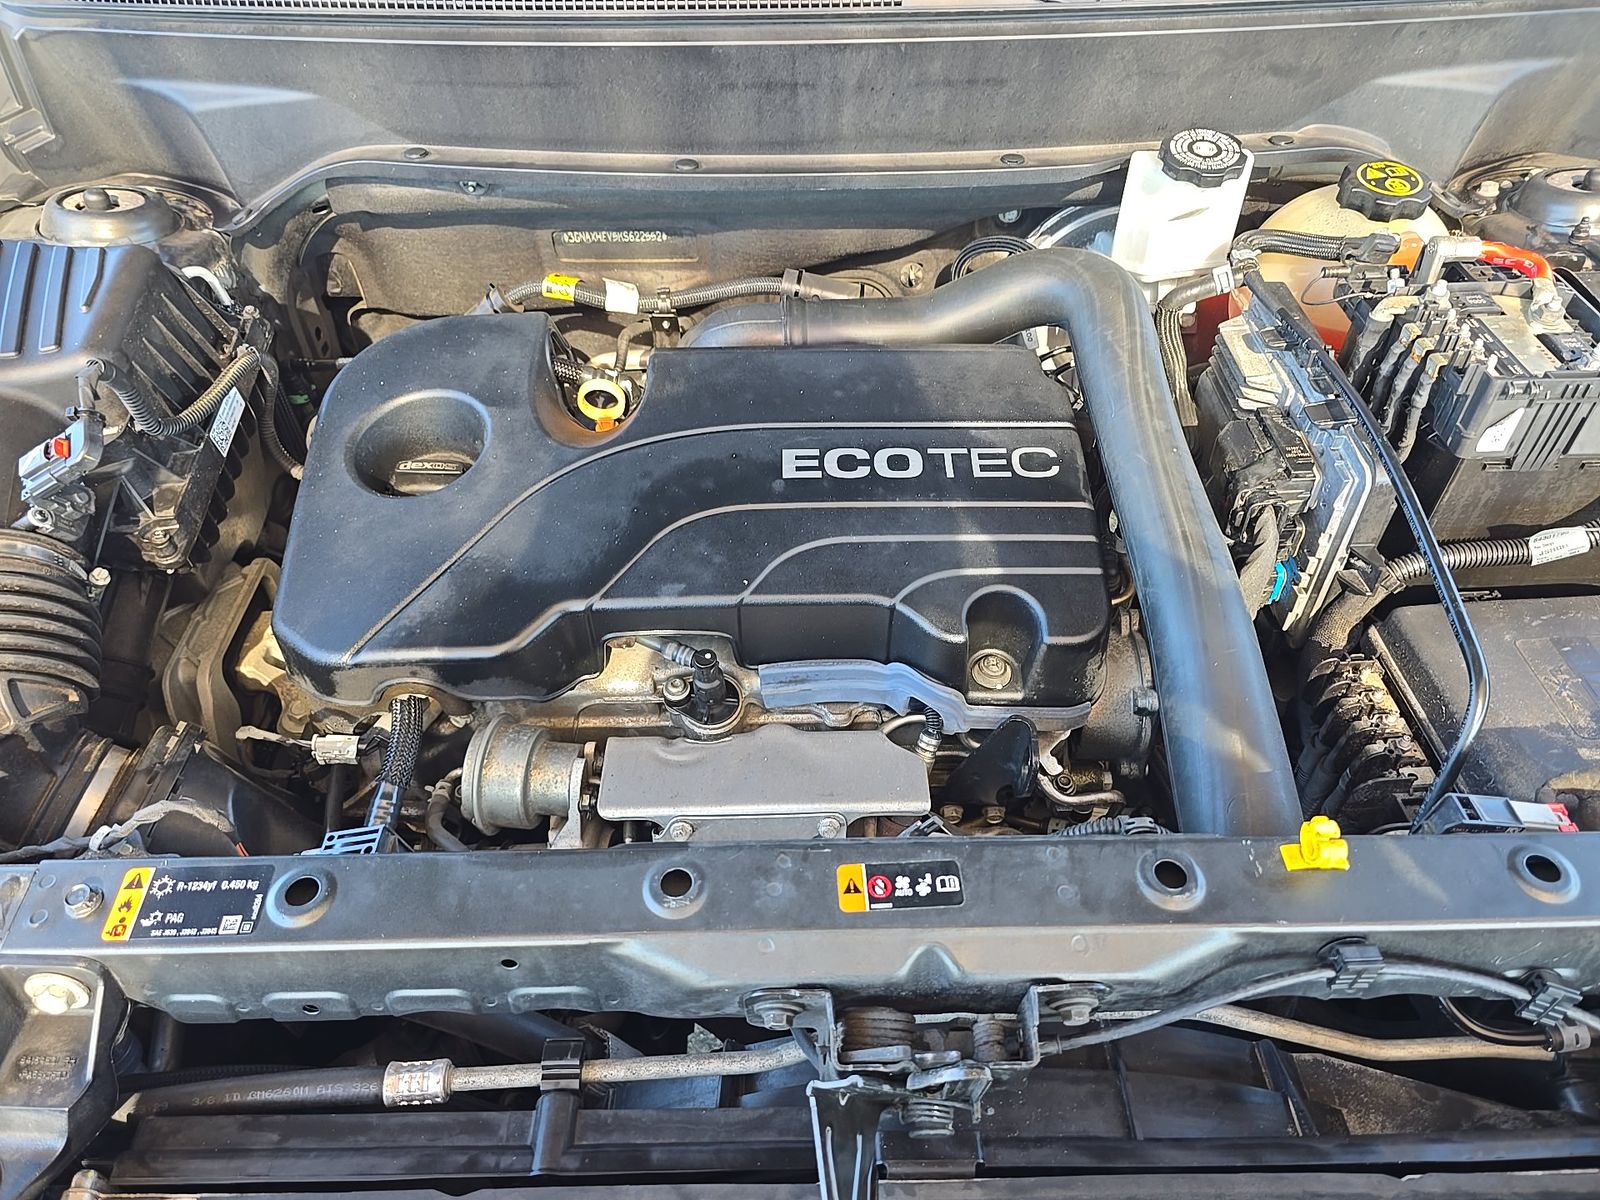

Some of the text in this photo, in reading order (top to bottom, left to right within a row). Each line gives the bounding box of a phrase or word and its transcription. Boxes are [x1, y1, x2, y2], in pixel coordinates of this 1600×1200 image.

[399, 461, 459, 470] dexos
[781, 446, 1061, 479] ECOTEC
[247, 879, 260, 891] kg
[164, 912, 185, 924] PAG
[352, 1082, 379, 1092] 326
